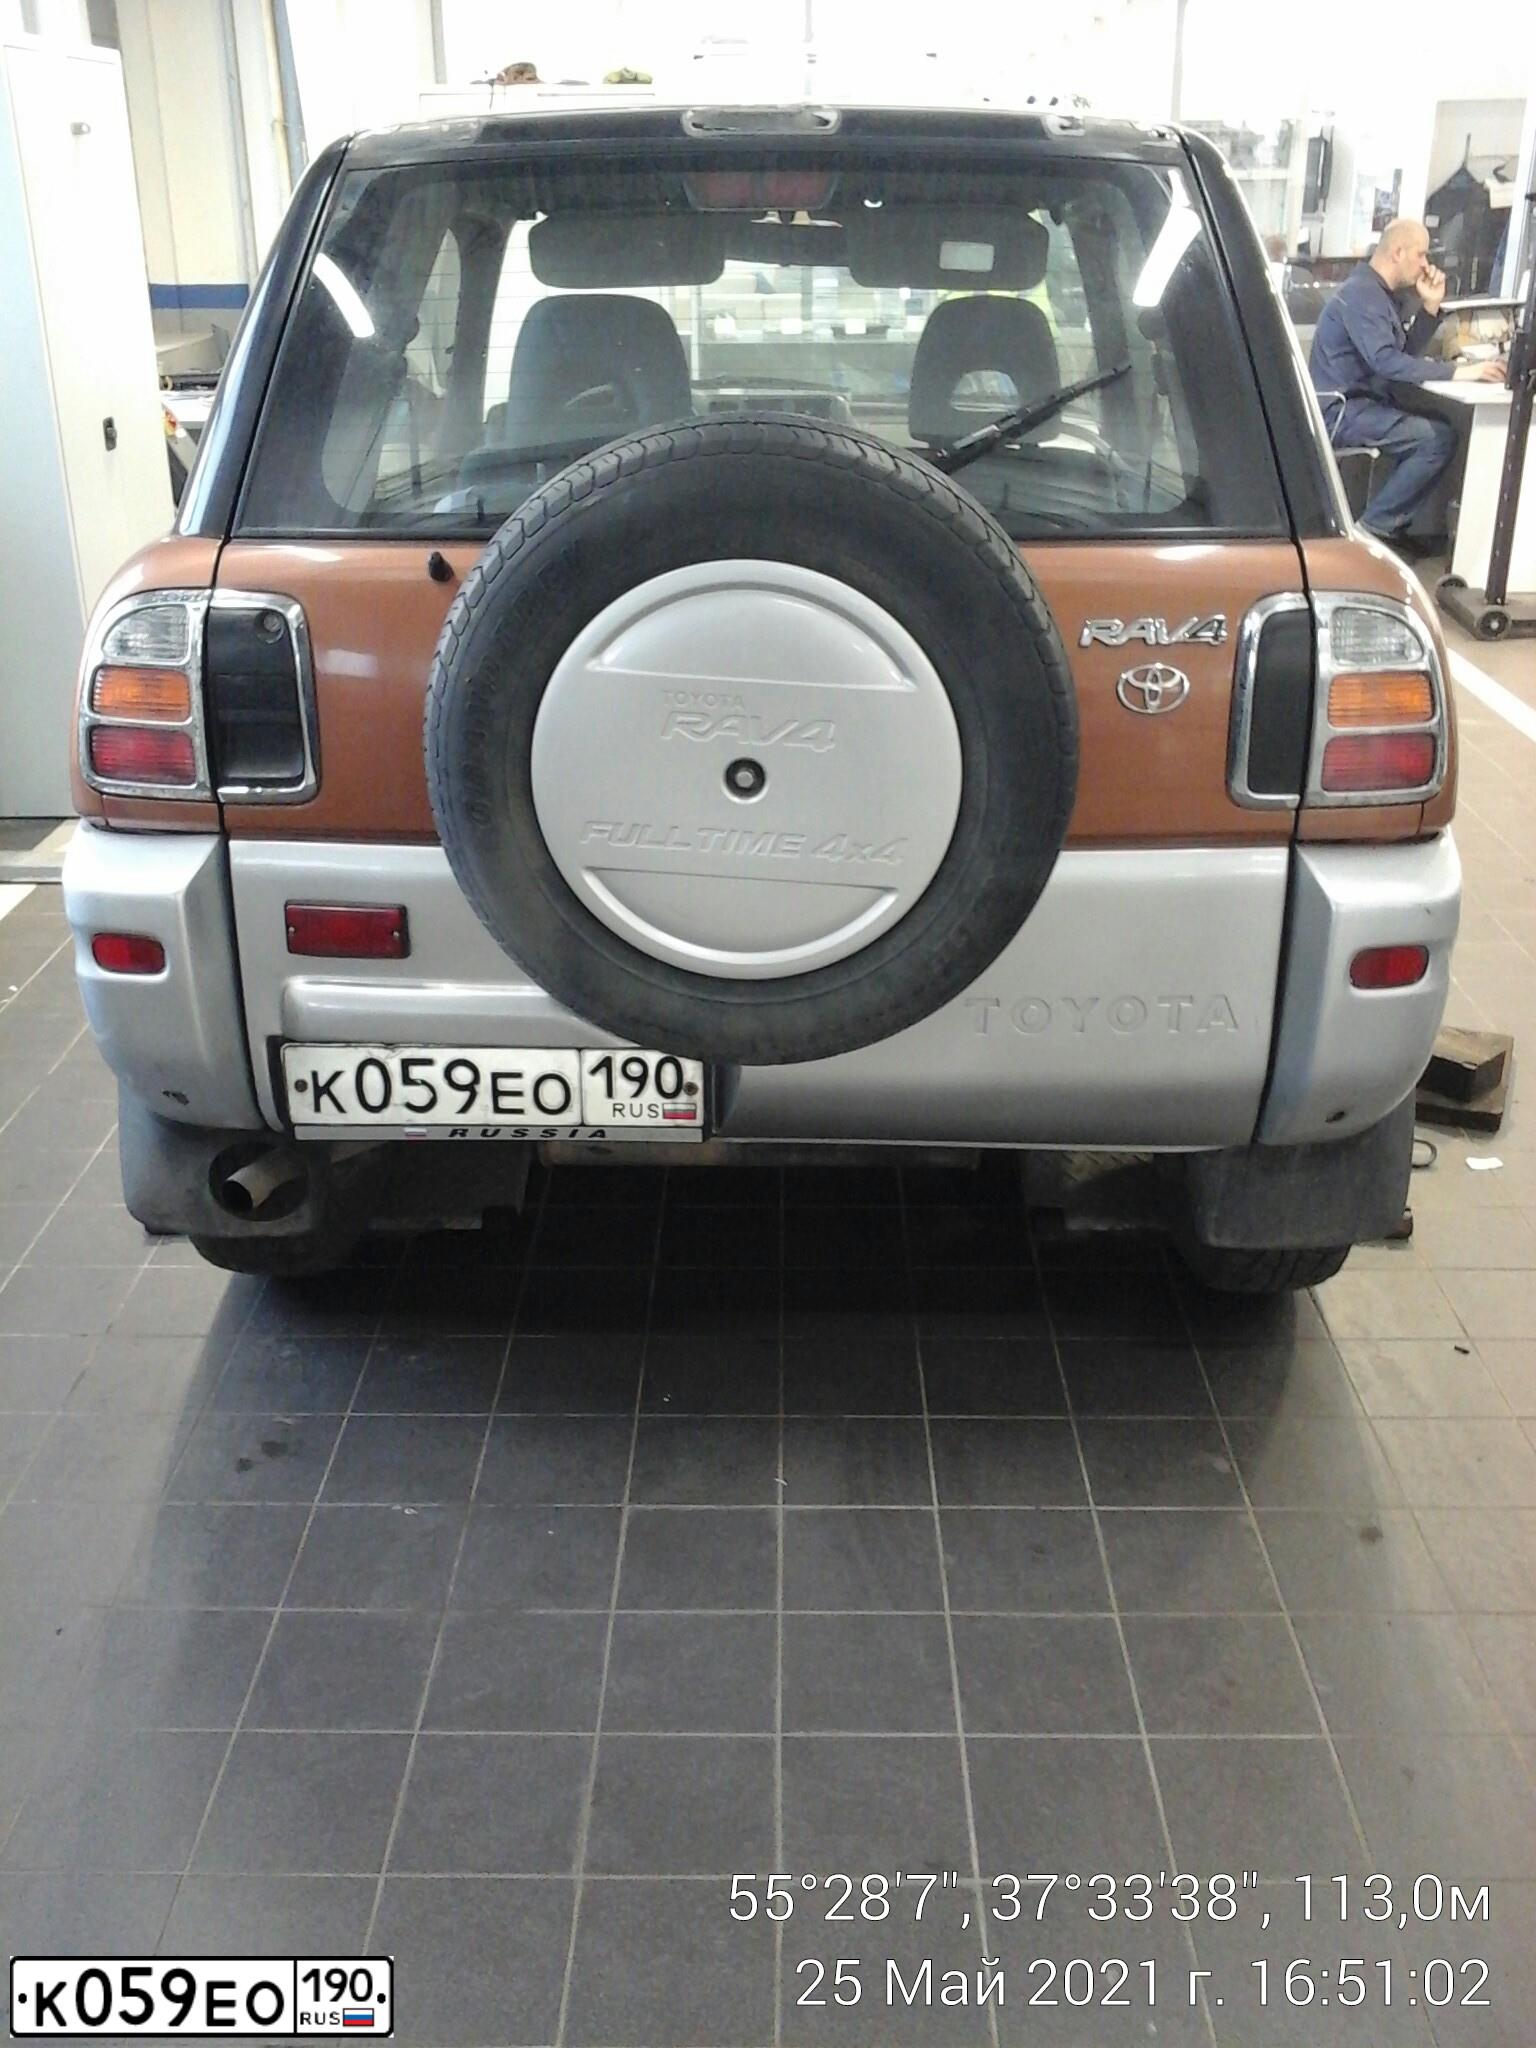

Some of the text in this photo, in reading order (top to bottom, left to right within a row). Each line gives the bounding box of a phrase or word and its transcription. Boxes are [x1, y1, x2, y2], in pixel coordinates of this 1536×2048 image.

[1078, 613, 1229, 649] RAV4
[662, 689, 745, 710] TOYOTA
[660, 710, 837, 753] RAV4
[579, 819, 693, 851] FULL
[696, 825, 807, 859] TIME
[964, 994, 1240, 1035] TOYOTA
[588, 1055, 686, 1100] 190
[611, 1102, 660, 1119] RUS
[447, 1128, 608, 1139] RUSSIA
